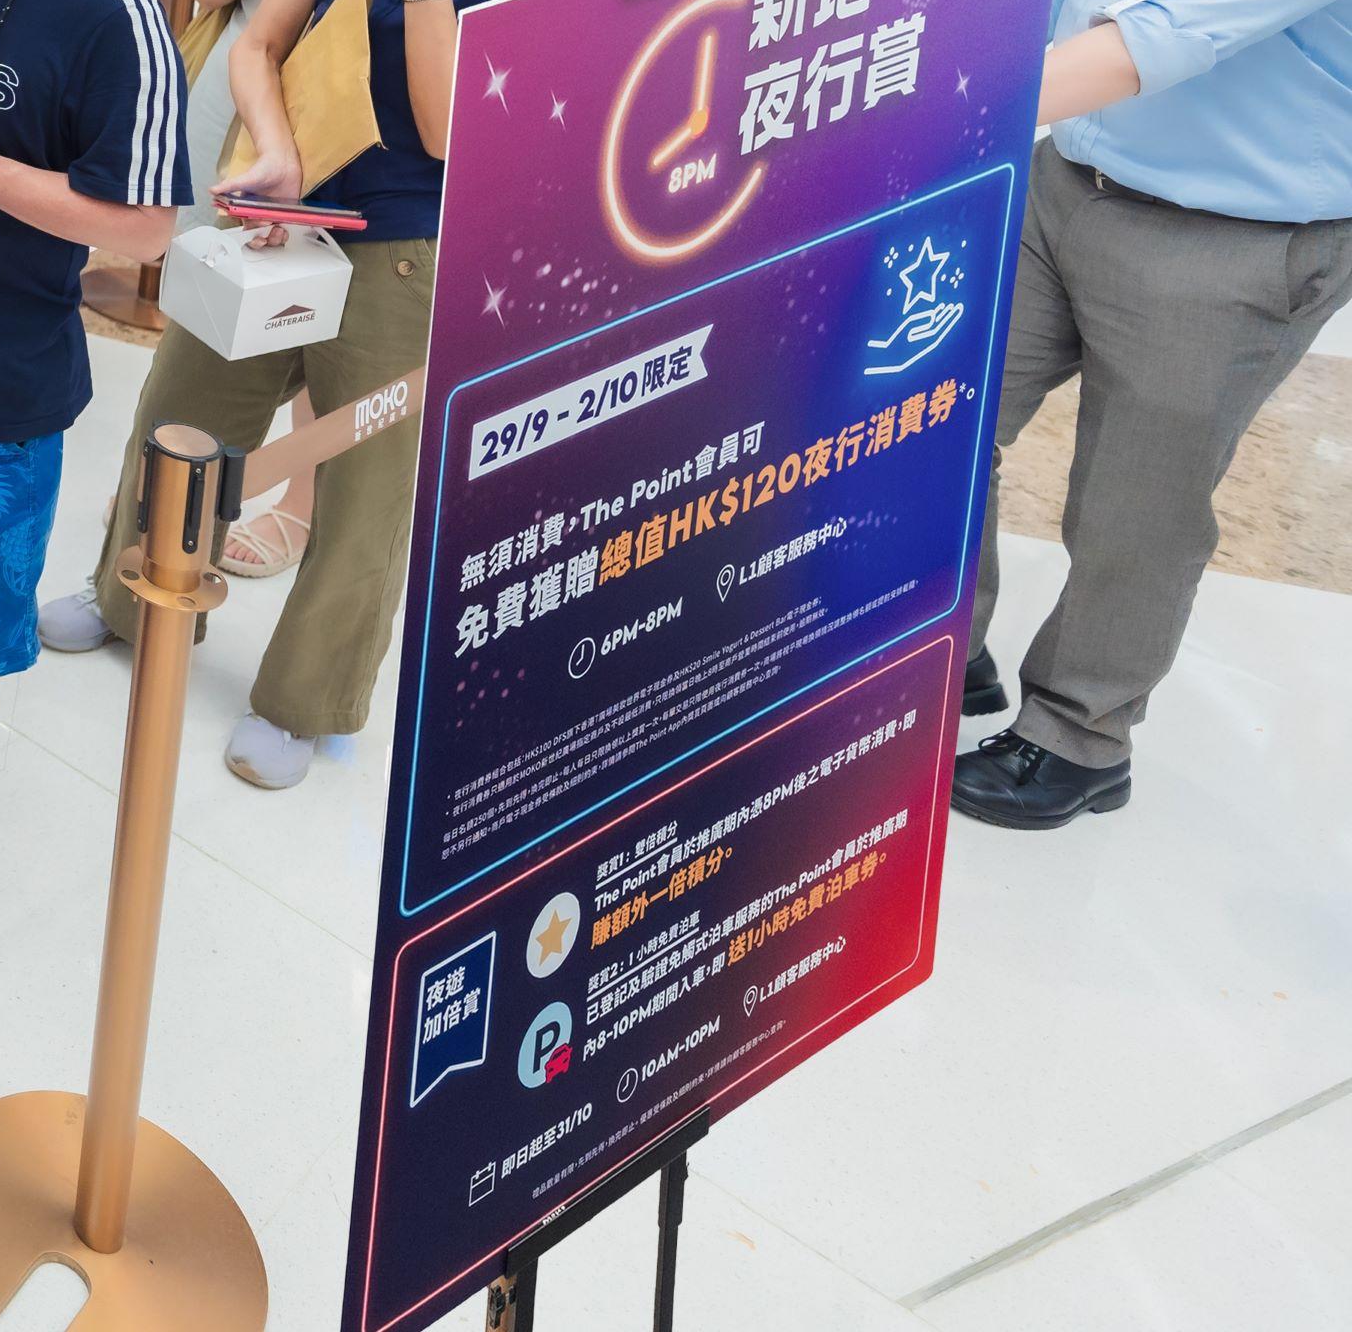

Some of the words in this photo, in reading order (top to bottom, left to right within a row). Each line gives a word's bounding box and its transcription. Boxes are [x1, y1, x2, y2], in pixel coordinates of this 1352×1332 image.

[735, 9, 926, 157] 夜行賞
[667, 152, 718, 195] 8PM
[355, 381, 408, 430] MOKO
[477, 406, 550, 470] 29/9
[576, 368, 638, 425] 2/10
[640, 342, 693, 397] 限定
[628, 418, 766, 513] Point會員可
[737, 509, 848, 590] L1顧客服務中心
[600, 594, 683, 657] 6PM-8PM
[634, 818, 678, 859] 雙倍積分
[798, 806, 908, 890] Point會員於推廣期
[590, 836, 734, 951] 賺額外一倍積分。
[593, 883, 619, 915] The
[425, 963, 465, 1013] 夜遊
[758, 932, 846, 1004] L1顧客服務中心
[422, 984, 481, 1046] 加倍賞
[640, 1012, 720, 1085] 10AM-10PM
[500, 1099, 593, 1181] 即日起至31/10
